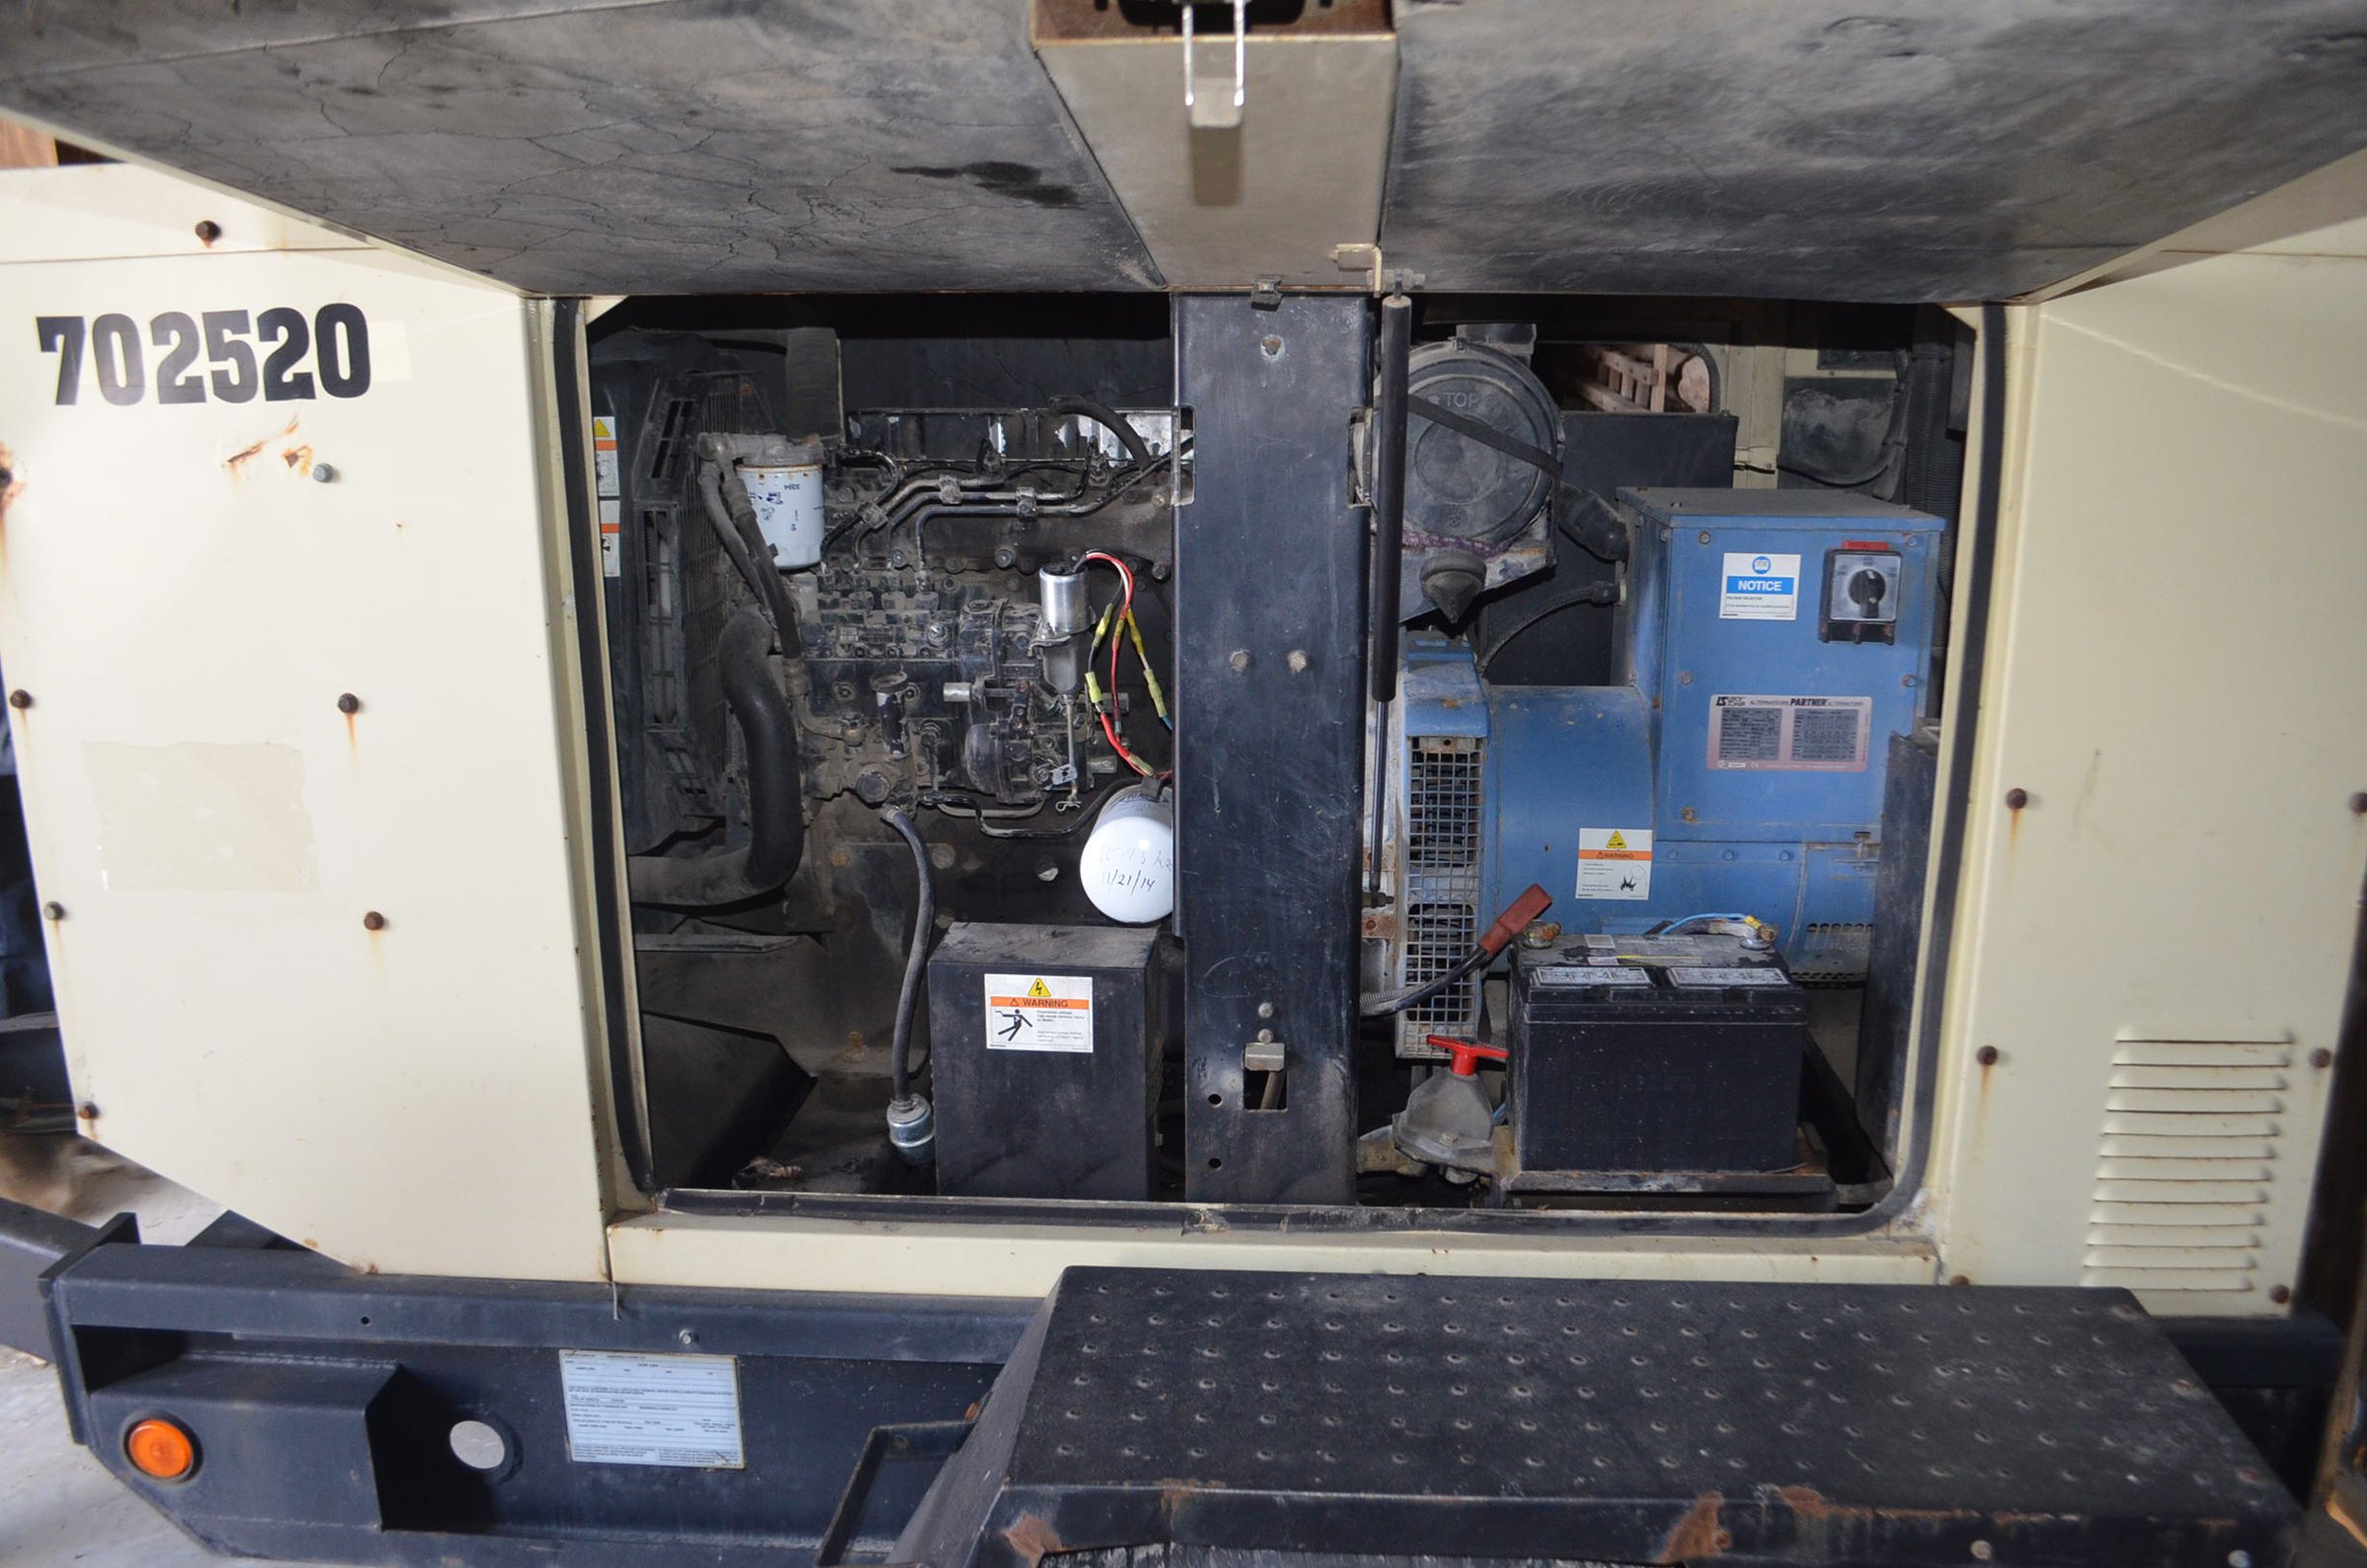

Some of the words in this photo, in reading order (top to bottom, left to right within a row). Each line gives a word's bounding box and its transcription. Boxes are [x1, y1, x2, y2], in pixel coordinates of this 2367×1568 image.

[35, 303, 371, 406] 702520
[1443, 392, 1479, 407] TOP
[1738, 580, 1782, 592] NOTICE
[1789, 697, 1829, 707] PARTNER
[1022, 998, 1069, 1008] WARNING
